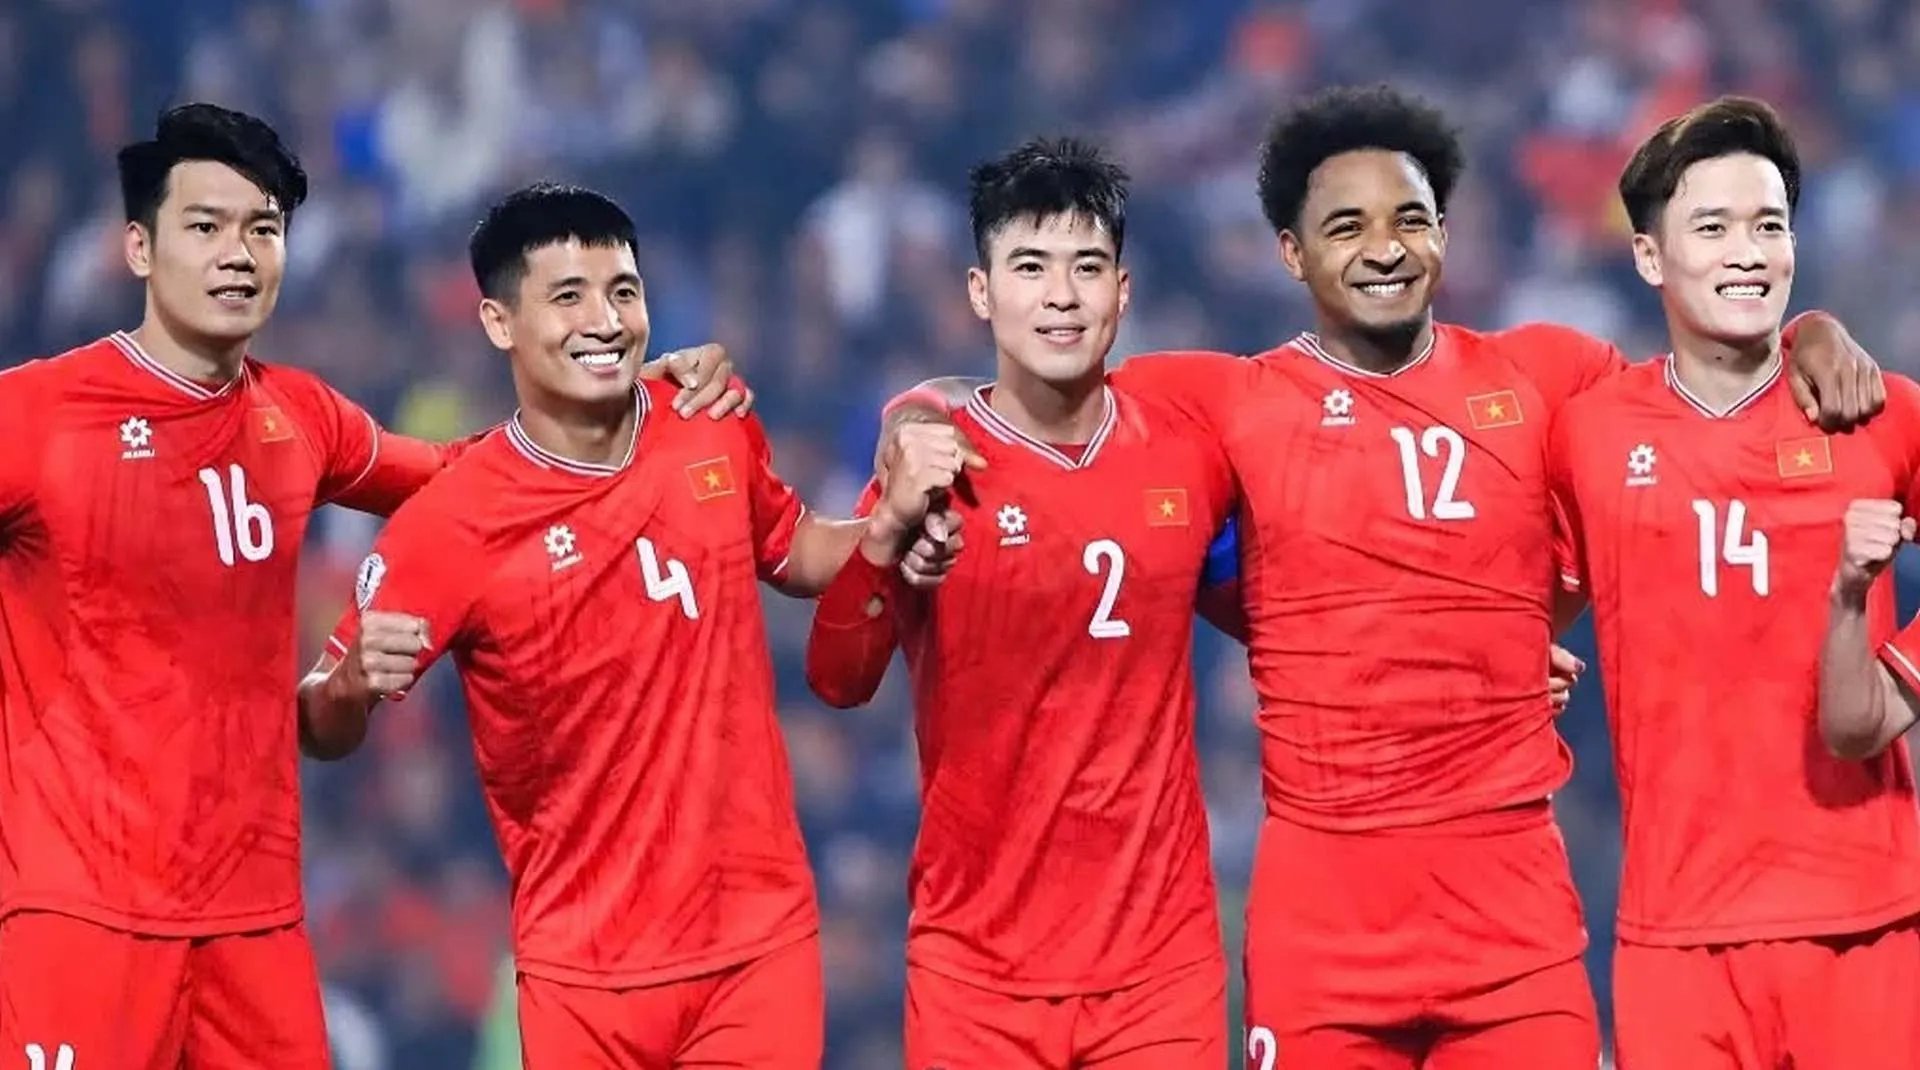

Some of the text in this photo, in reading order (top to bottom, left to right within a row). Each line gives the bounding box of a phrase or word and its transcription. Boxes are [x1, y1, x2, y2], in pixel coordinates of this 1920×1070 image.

[198, 463, 275, 566] 16
[1389, 425, 1476, 520] 12
[636, 537, 699, 619] 4
[1083, 539, 1130, 638] 2
[1692, 499, 1770, 597] 14
